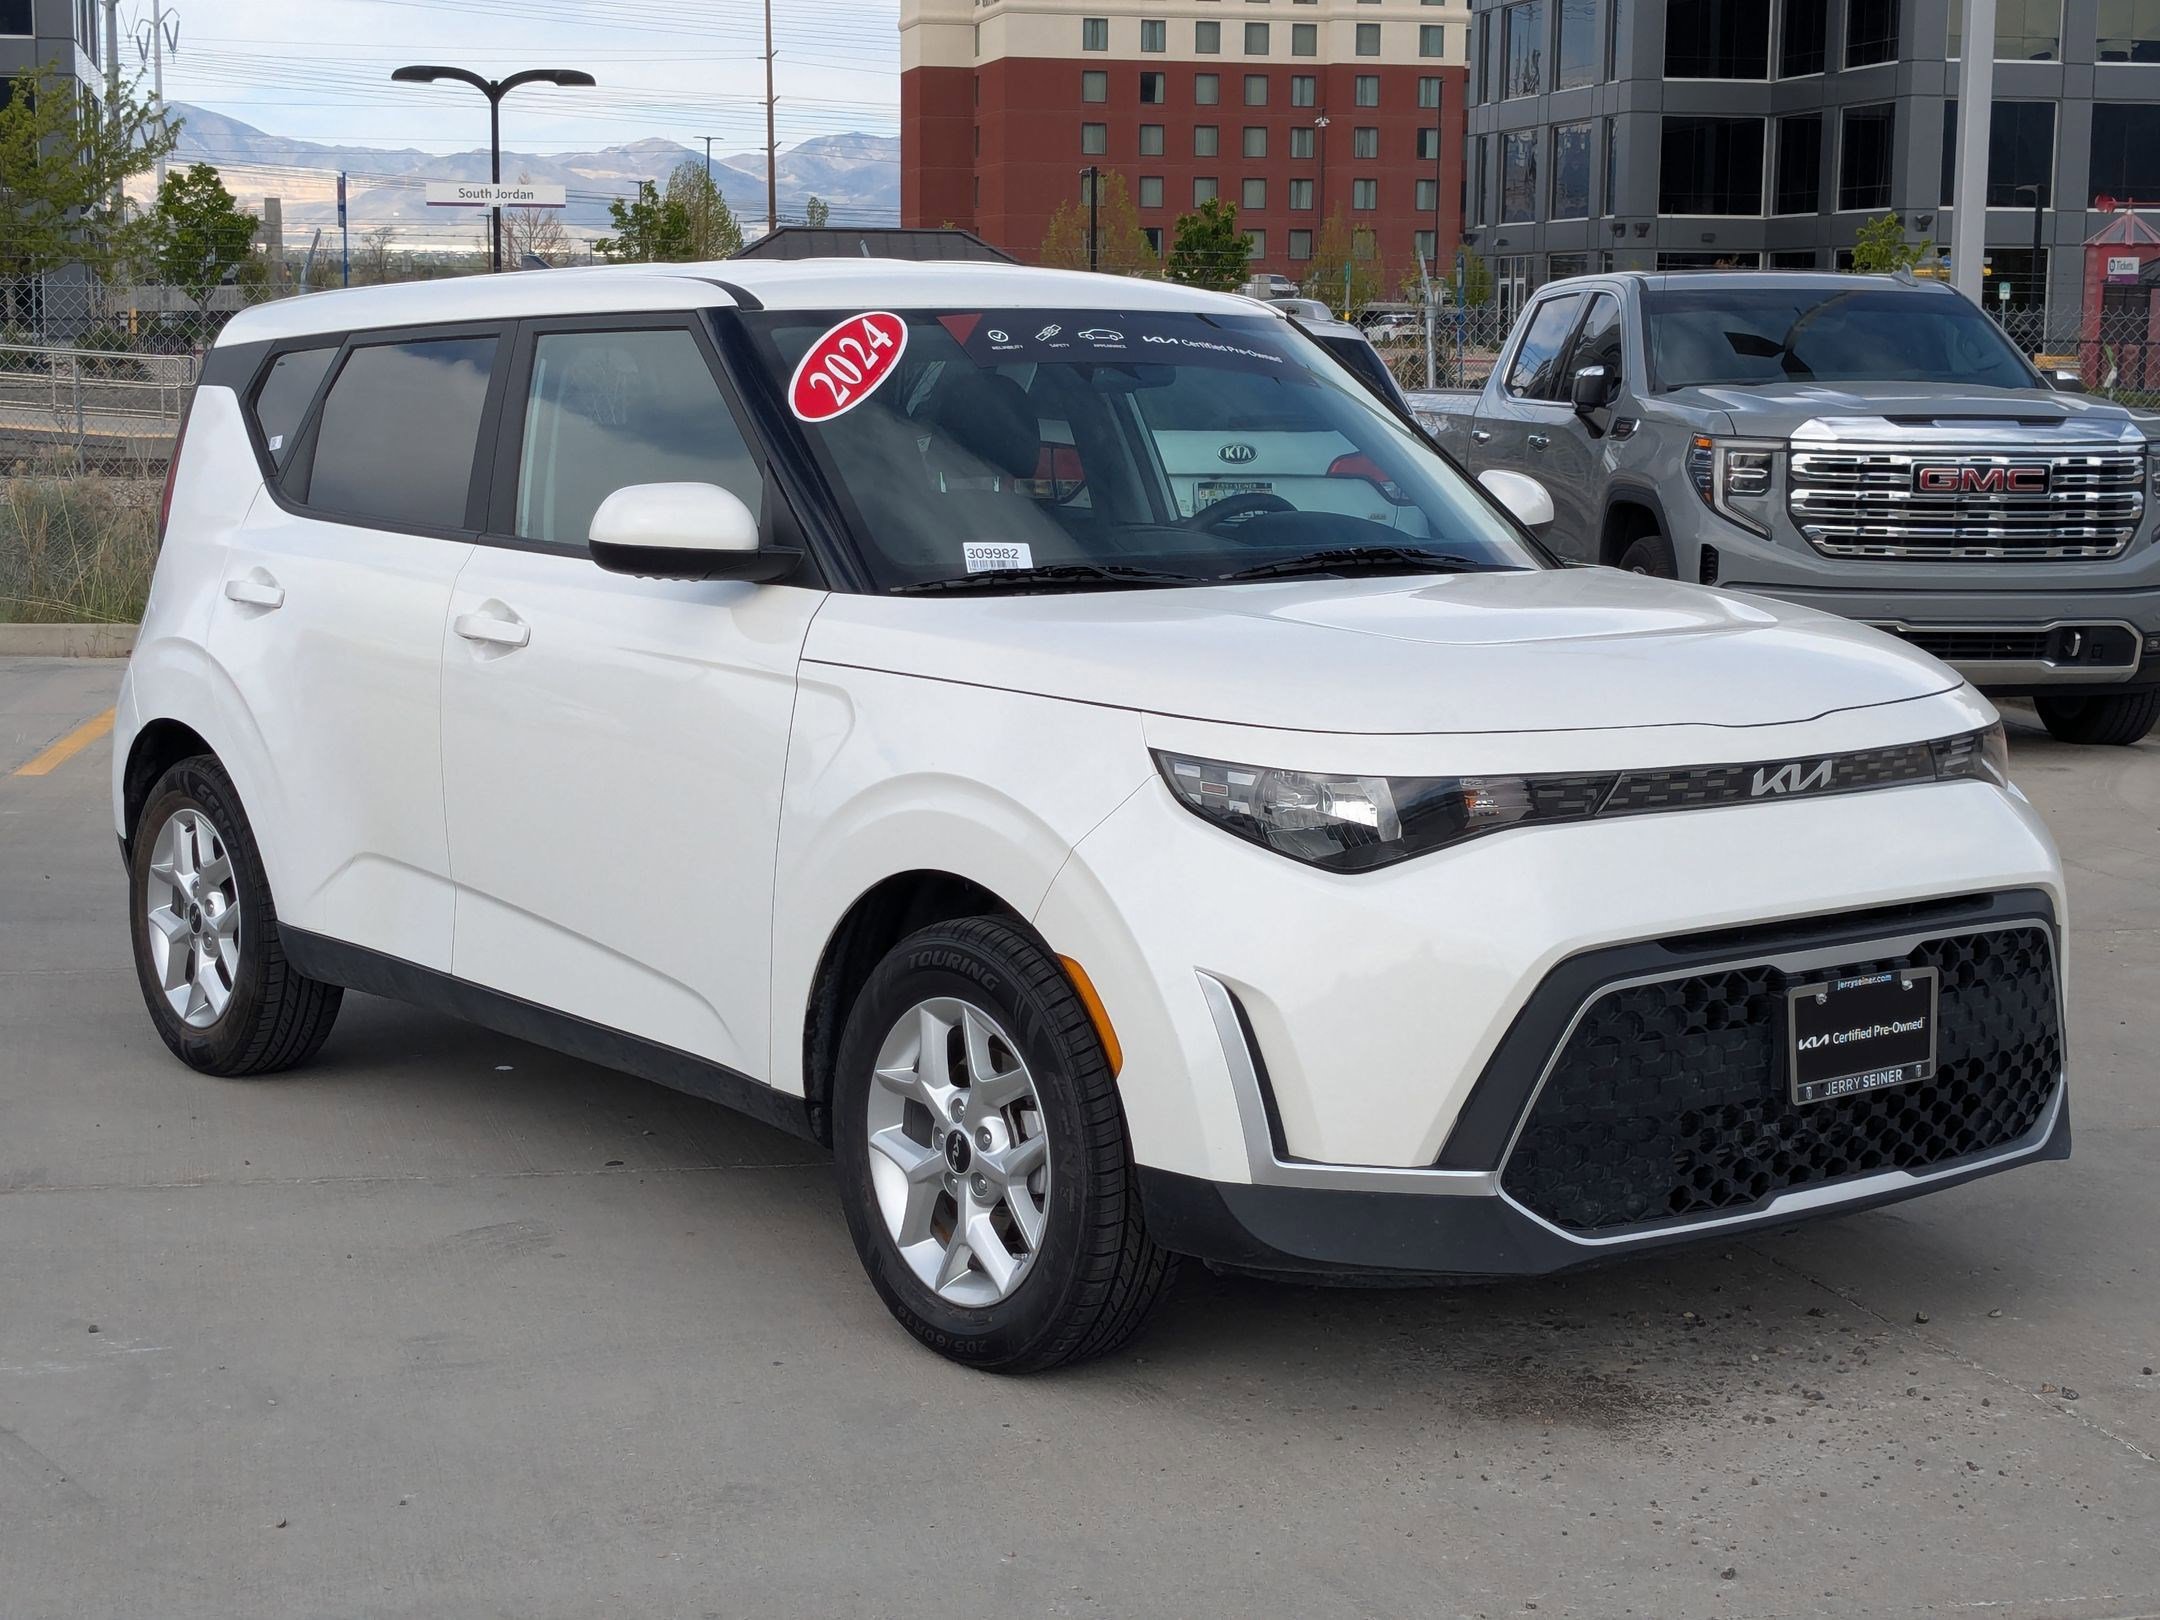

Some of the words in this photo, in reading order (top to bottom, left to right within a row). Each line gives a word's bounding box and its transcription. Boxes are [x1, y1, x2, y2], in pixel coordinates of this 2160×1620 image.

[458, 188, 492, 199] South
[495, 188, 534, 200] Jordan
[1181, 338, 1228, 352] Certified
[809, 318, 894, 407] 2024
[1225, 445, 1253, 459] KIA
[1919, 467, 2046, 493] GMC
[966, 548, 1020, 560] 309982
[1750, 759, 1833, 797] KIA
[908, 950, 1001, 992] TOURING
[1837, 974, 1892, 991] jerryseiner.com
[1798, 1033, 1830, 1051] KIA
[1832, 1026, 1872, 1045] Certified
[1825, 1076, 1861, 1096] JERRY
[1862, 1069, 1903, 1088] SEINER
